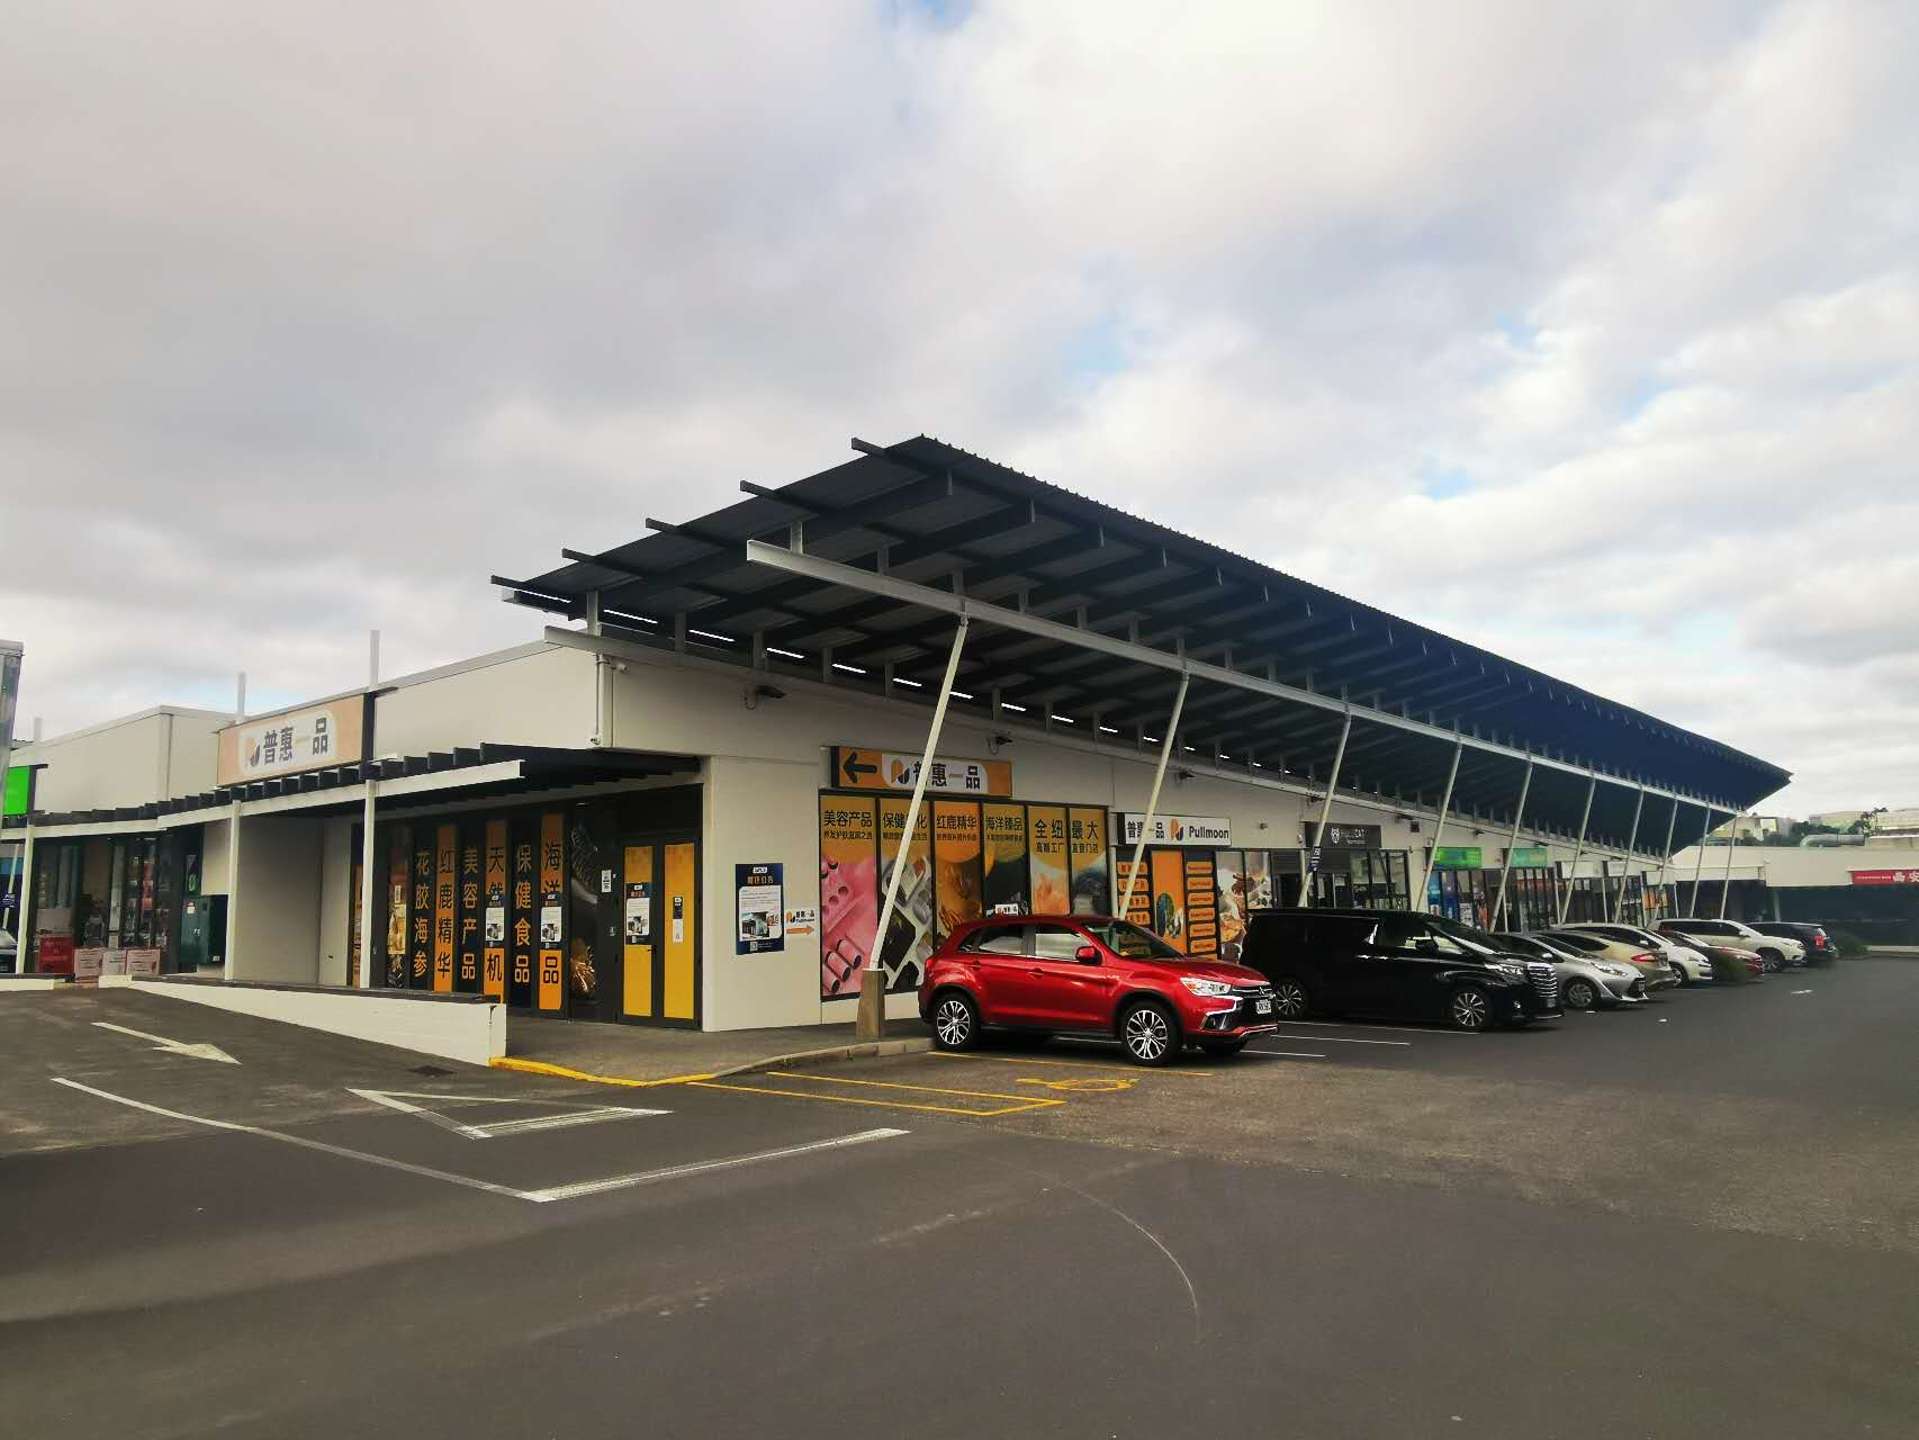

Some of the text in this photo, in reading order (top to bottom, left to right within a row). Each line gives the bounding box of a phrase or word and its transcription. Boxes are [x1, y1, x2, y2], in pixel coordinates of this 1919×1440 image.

[262, 717, 328, 764] 普惠一品
[824, 810, 872, 827] 美容产品
[884, 812, 928, 829] 保健化
[937, 815, 977, 829] 红鹿精华
[1189, 826, 1229, 839] Pullmoon
[414, 848, 431, 977] 花胶海参
[438, 849, 454, 978] 红鹿精华
[461, 847, 478, 980] 美容产品
[486, 846, 504, 982] 天然机
[514, 844, 532, 983] 保健食品
[543, 841, 561, 984] 海洋品
